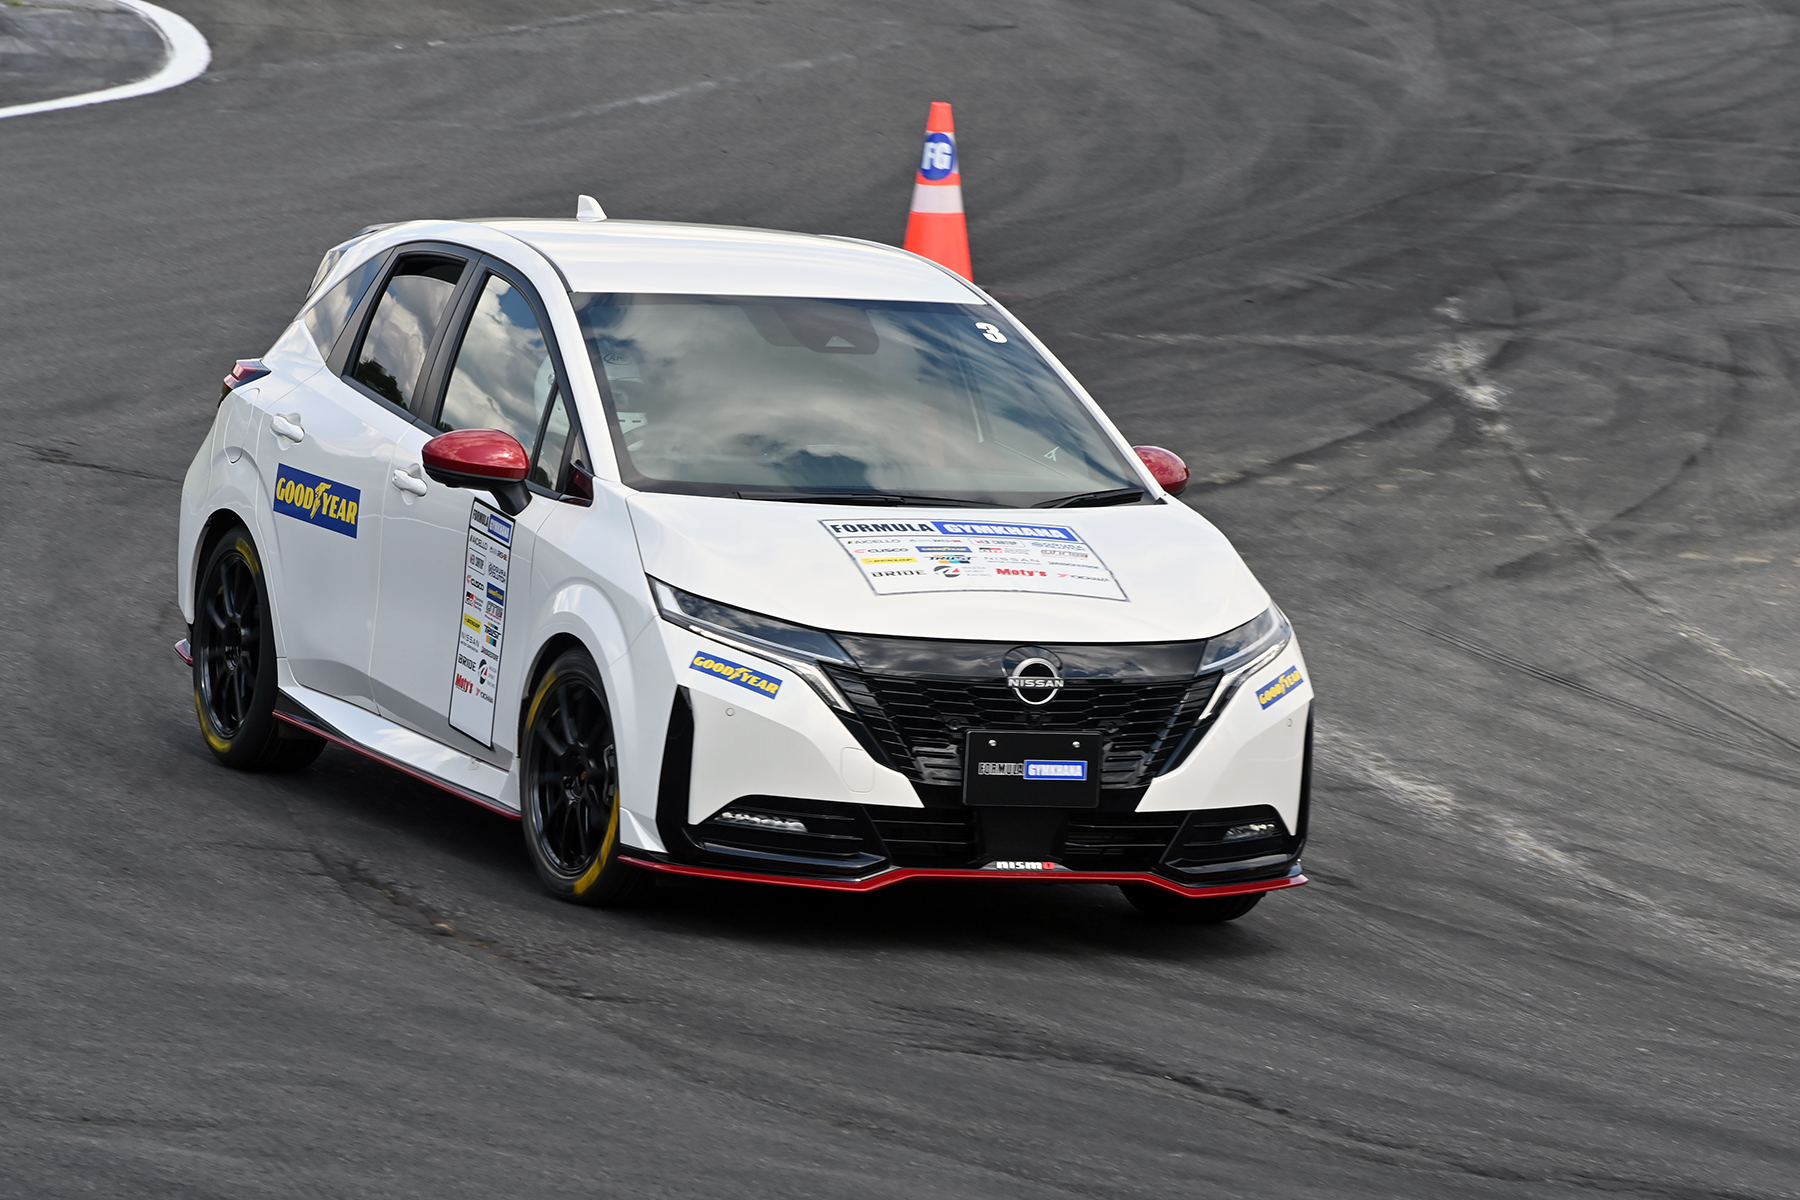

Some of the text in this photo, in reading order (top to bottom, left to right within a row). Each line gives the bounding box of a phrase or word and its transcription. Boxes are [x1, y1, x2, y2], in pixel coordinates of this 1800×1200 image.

[921, 142, 953, 170] FG
[975, 322, 1008, 343] 3
[276, 477, 358, 525] GOODYEAR
[830, 523, 1069, 539] FORMULA GYMKHANA
[871, 569, 927, 577] BRIDE
[458, 653, 477, 672] BRIDE
[693, 656, 779, 694] GOODYEAR
[1008, 679, 1064, 687] NISSAN
[978, 762, 1024, 775] FORMULA
[996, 861, 1055, 870] nismo
